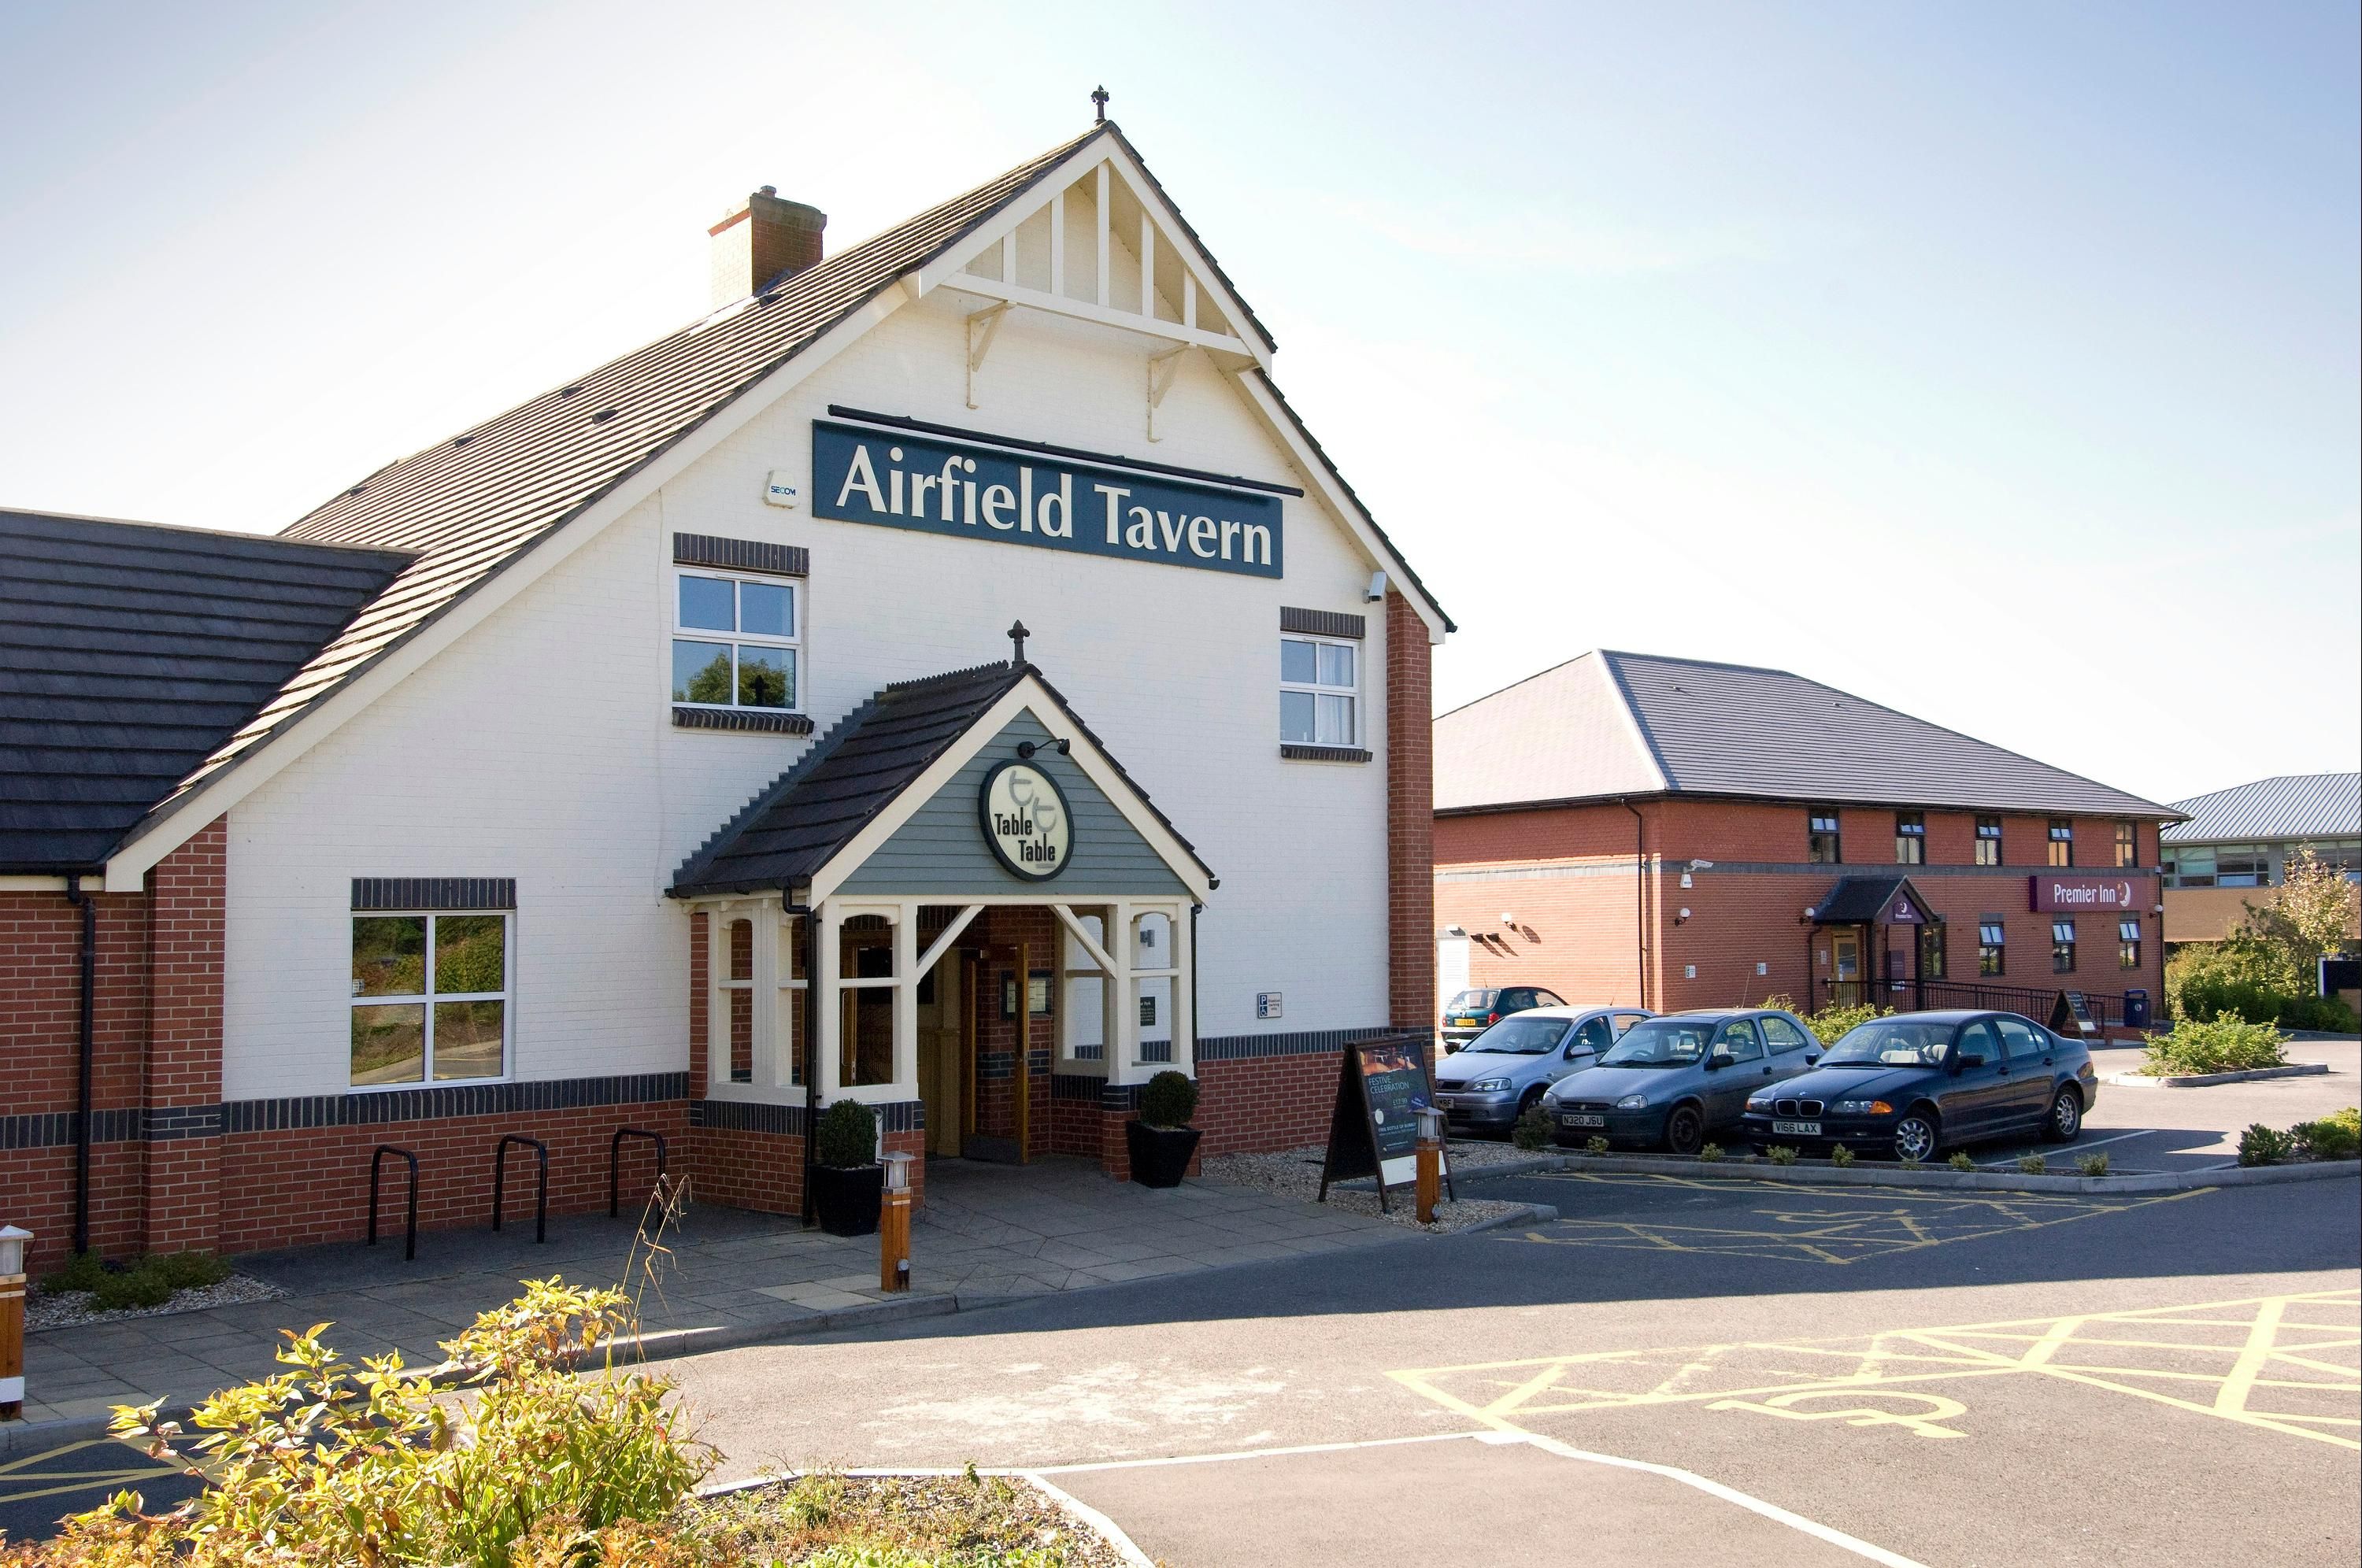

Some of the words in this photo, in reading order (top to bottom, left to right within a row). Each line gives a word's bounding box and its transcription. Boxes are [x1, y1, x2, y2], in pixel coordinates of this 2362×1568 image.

[771, 485, 796, 496] SECOM
[835, 445, 1072, 538] Airfield
[1094, 483, 1272, 566] Tavern
[994, 806, 1032, 836] Table
[1018, 833, 1056, 862] Table
[2053, 883, 2097, 904] Premier
[2099, 884, 2116, 903] Inn
[1261, 996, 1267, 1004] P
[1368, 1075, 1391, 1085] FESTIVE
[1370, 1082, 1409, 1093] CELEBRATION
[1564, 1115, 1584, 1125] N320
[1775, 1122, 1795, 1133] V166
[1797, 1123, 1817, 1133] LAX
